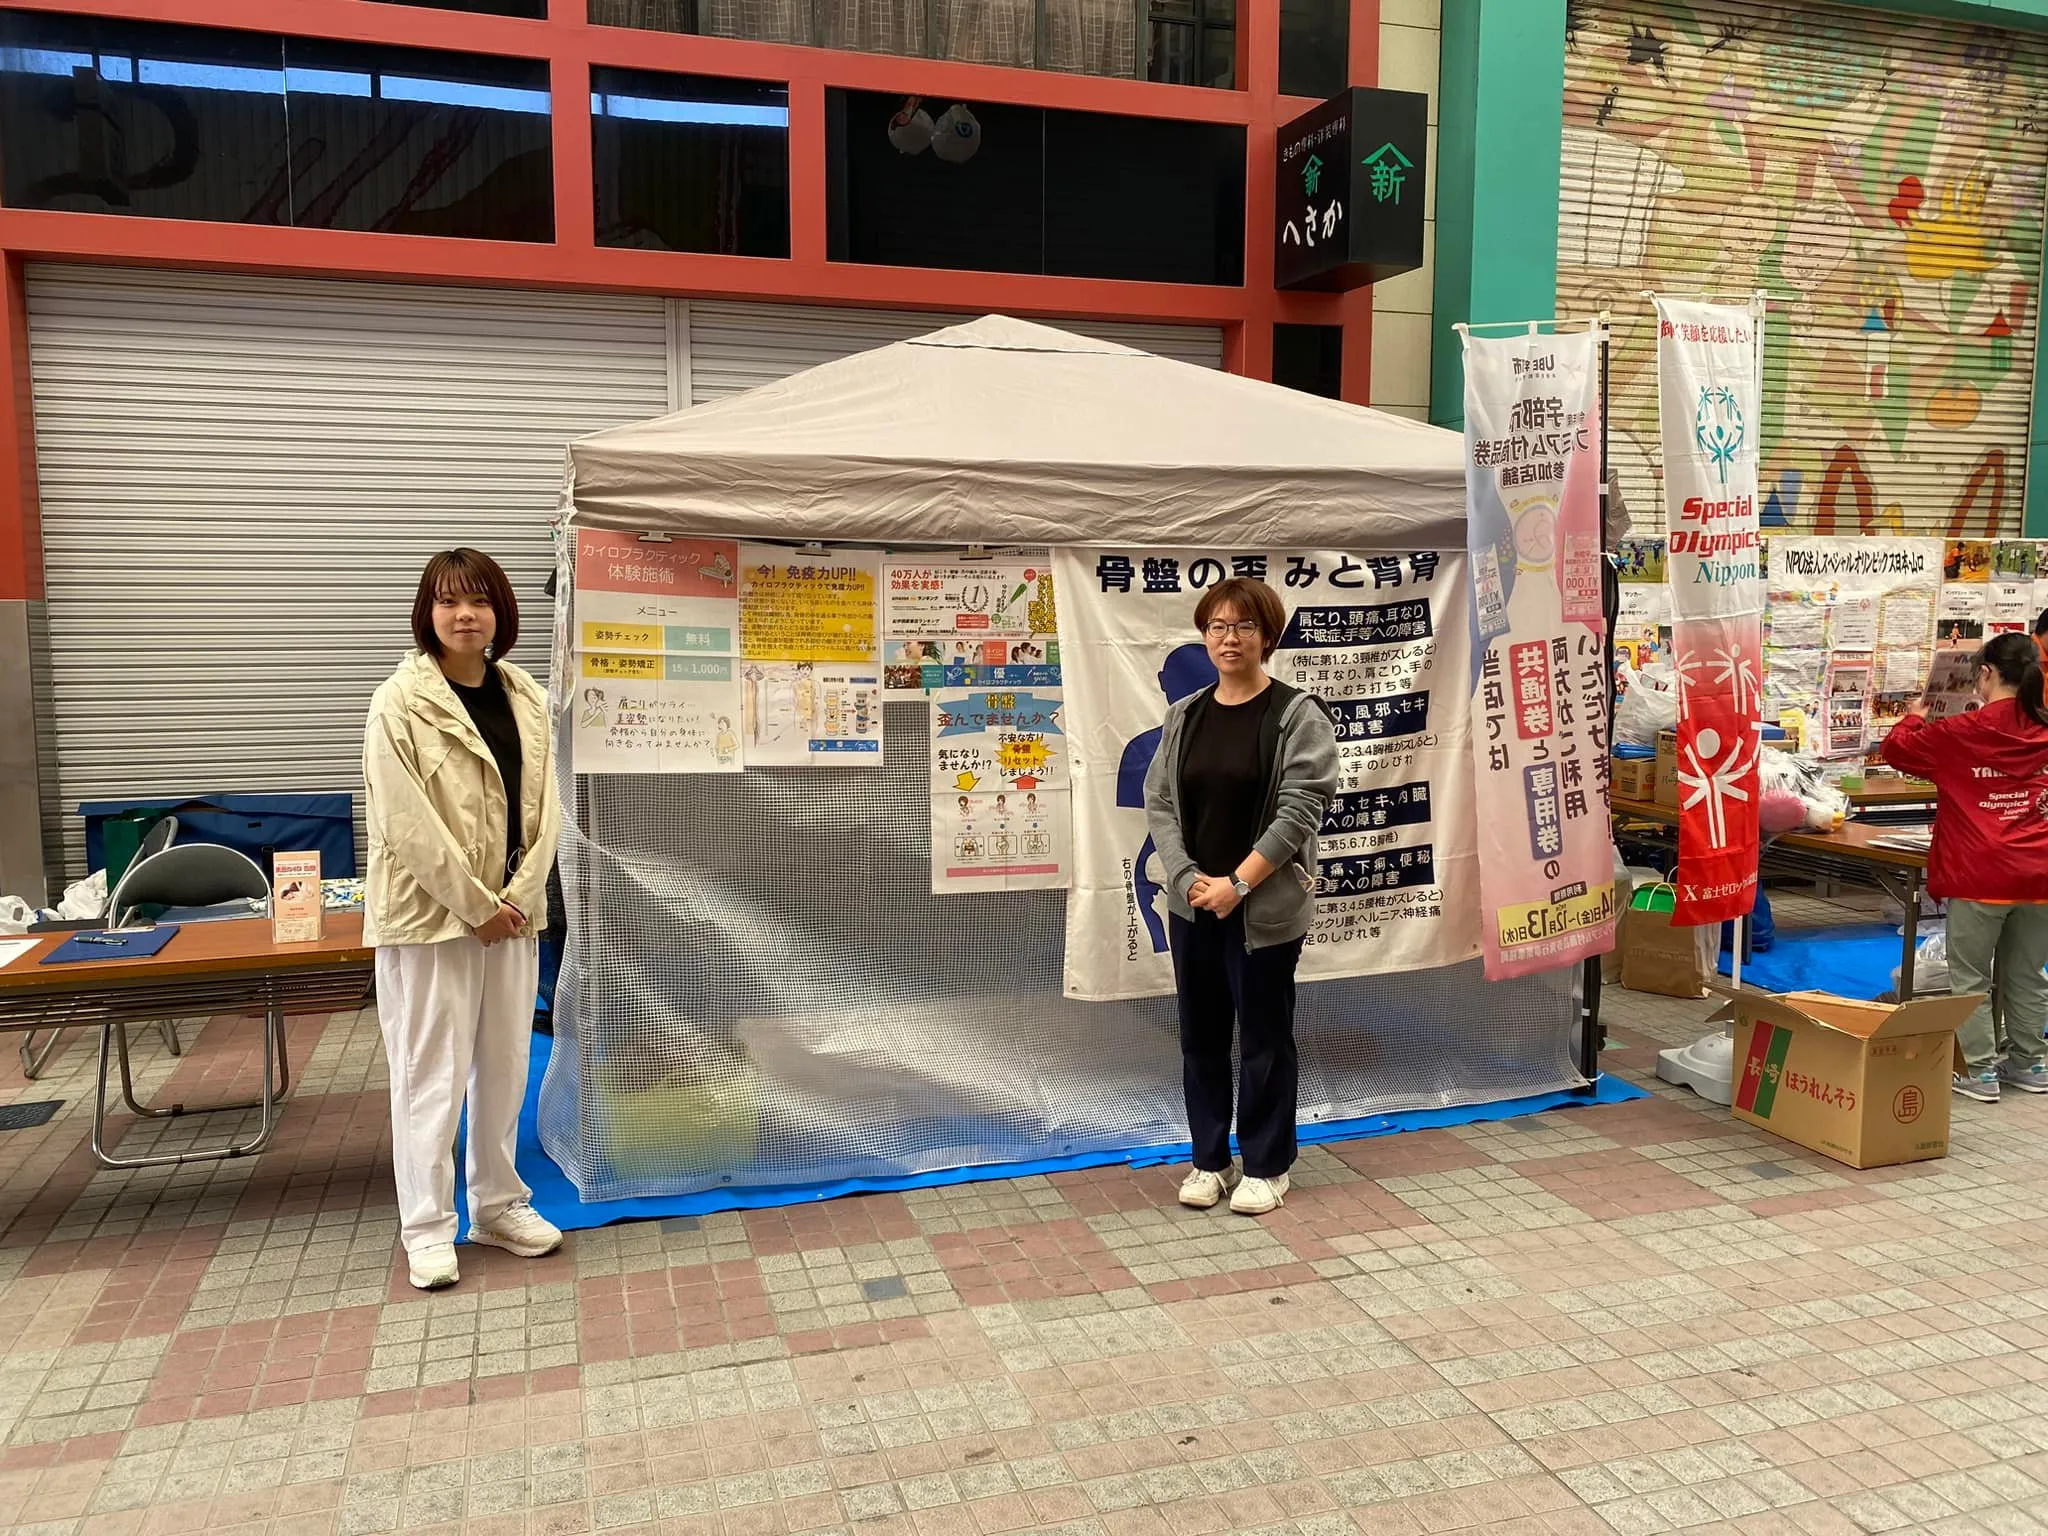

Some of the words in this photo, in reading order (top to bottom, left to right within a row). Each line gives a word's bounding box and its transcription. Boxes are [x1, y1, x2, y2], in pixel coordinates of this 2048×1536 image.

[1681, 495, 1752, 525] Special
[1670, 527, 1761, 558] Olympics
[582, 543, 701, 563] カイロプラクティック
[608, 563, 675, 584] 体験施術
[891, 570, 932, 579] 40万人が
[1694, 561, 1756, 586] Nippon
[891, 580, 943, 591] 効果を実感!
[638, 607, 678, 616] メニュー
[1299, 604, 1424, 627] 肩こり、頭痛、耳なり
[595, 630, 649, 641] 姿勢チェック
[685, 632, 710, 645] 無料
[1300, 620, 1427, 643] 不眠症、手等への障害
[1296, 659, 1433, 683] 目、耳なり、肩こり、手の
[1297, 677, 1413, 697] びれ、むち打ち等
[937, 712, 1059, 728] 歪んでませんか?
[938, 749, 980, 760] 気になり
[1339, 755, 1413, 773] 、手のしびれ
[1989, 790, 2029, 800] Special
[1979, 800, 2030, 810] Olympics
[1320, 810, 1387, 828] への障害
[1785, 1070, 1856, 1112] ほうれんそう
[1897, 1089, 1919, 1118] 島
